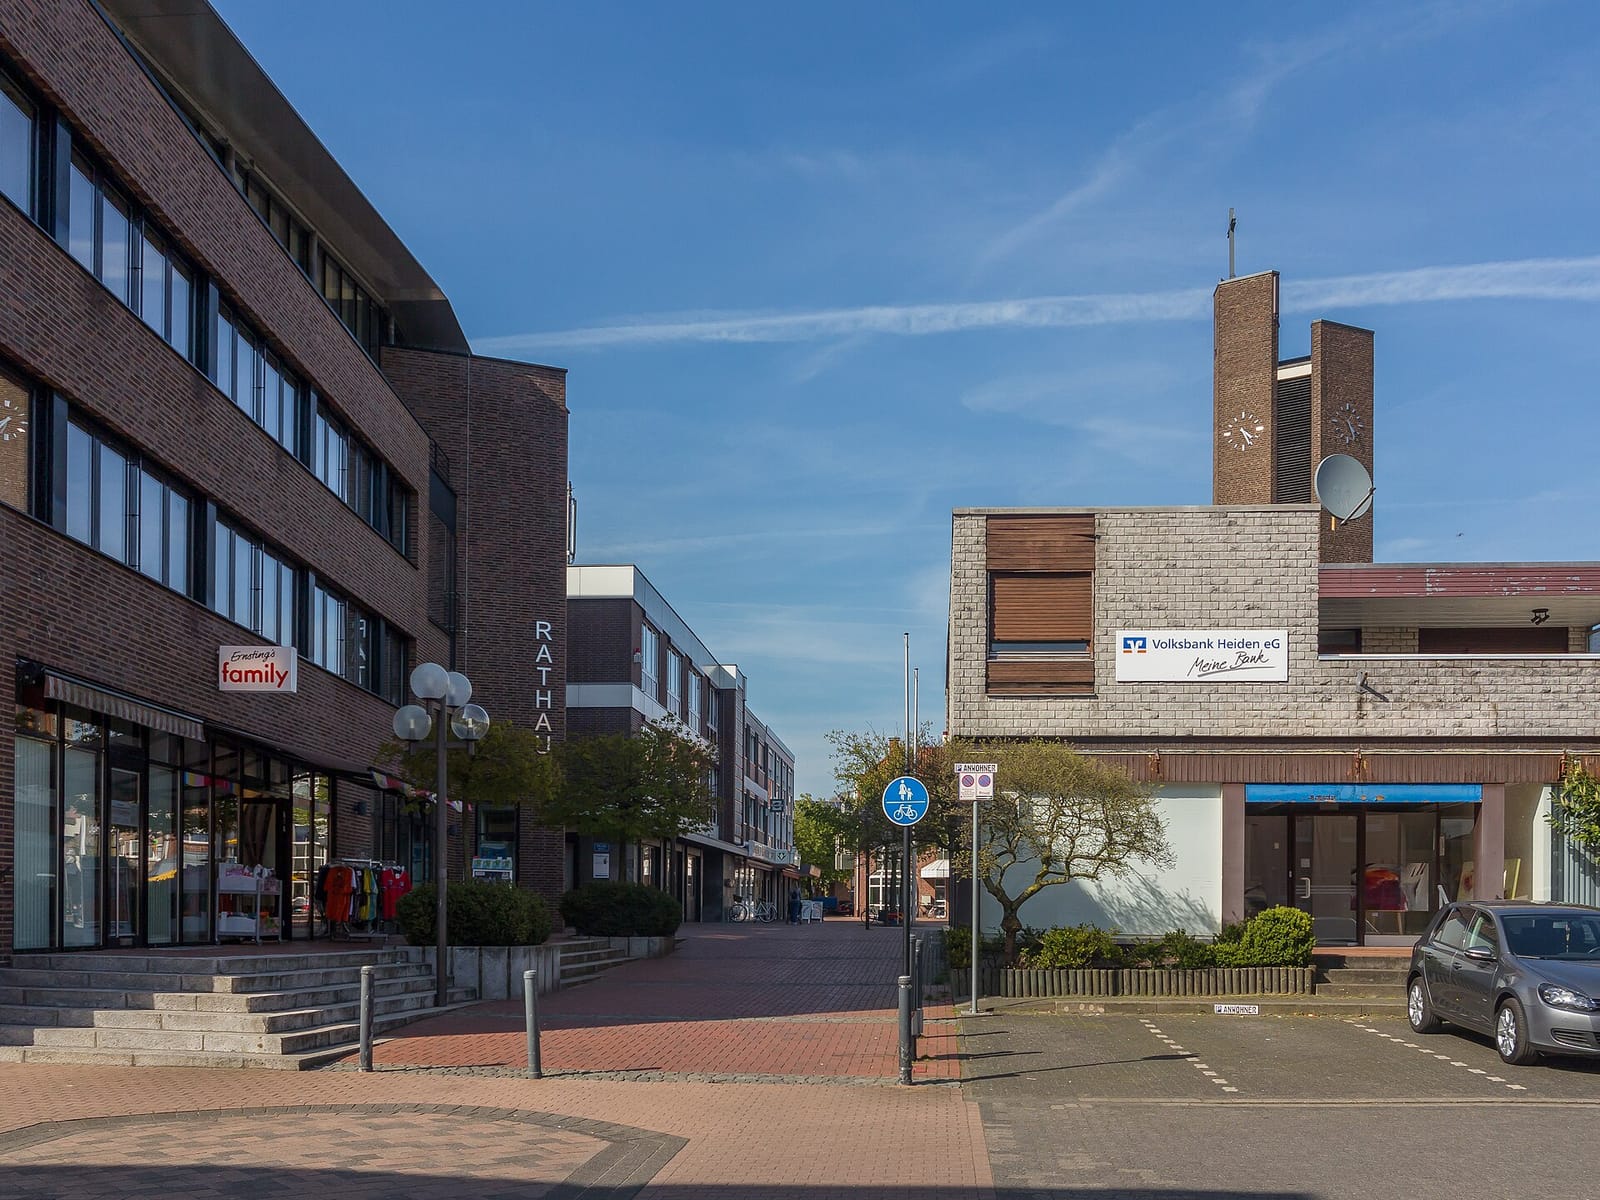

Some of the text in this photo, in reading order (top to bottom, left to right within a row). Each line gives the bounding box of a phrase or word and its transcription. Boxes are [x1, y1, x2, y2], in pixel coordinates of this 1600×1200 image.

[1152, 638, 1280, 650] Volksbank Heiden eG
[230, 649, 276, 662] Ernsting's
[1187, 649, 1269, 676] Meine Bank
[222, 661, 289, 688] family
[535, 620, 553, 755] RATHAU
[964, 764, 996, 772] ANWOHNER
[1223, 1005, 1257, 1014] ANWOHNER
